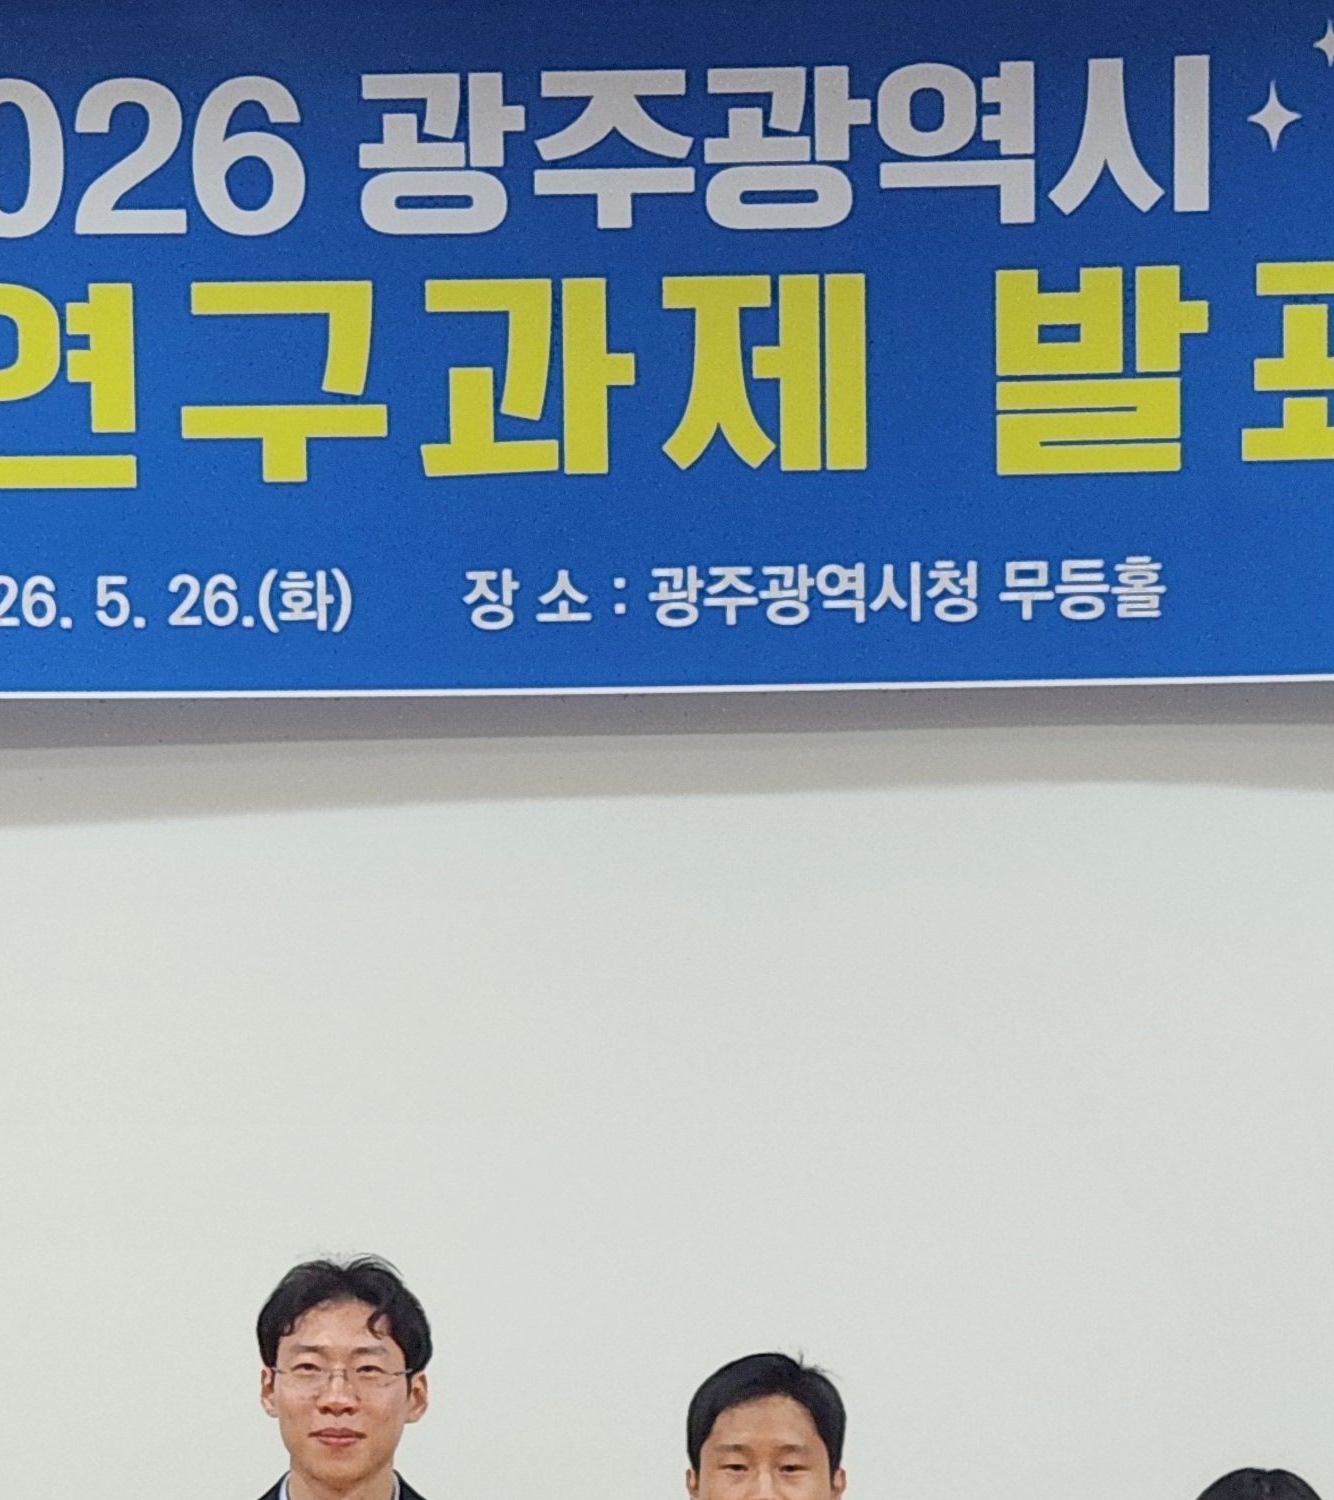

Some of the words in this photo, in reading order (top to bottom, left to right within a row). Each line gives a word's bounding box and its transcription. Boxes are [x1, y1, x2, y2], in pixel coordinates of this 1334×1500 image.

[358, 55, 1210, 235] 광주광역시
[96, 575, 146, 629] 5.
[168, 568, 352, 633] 26.(화)
[648, 560, 978, 627] 광주광역시청
[999, 555, 1167, 620] 무등홀
